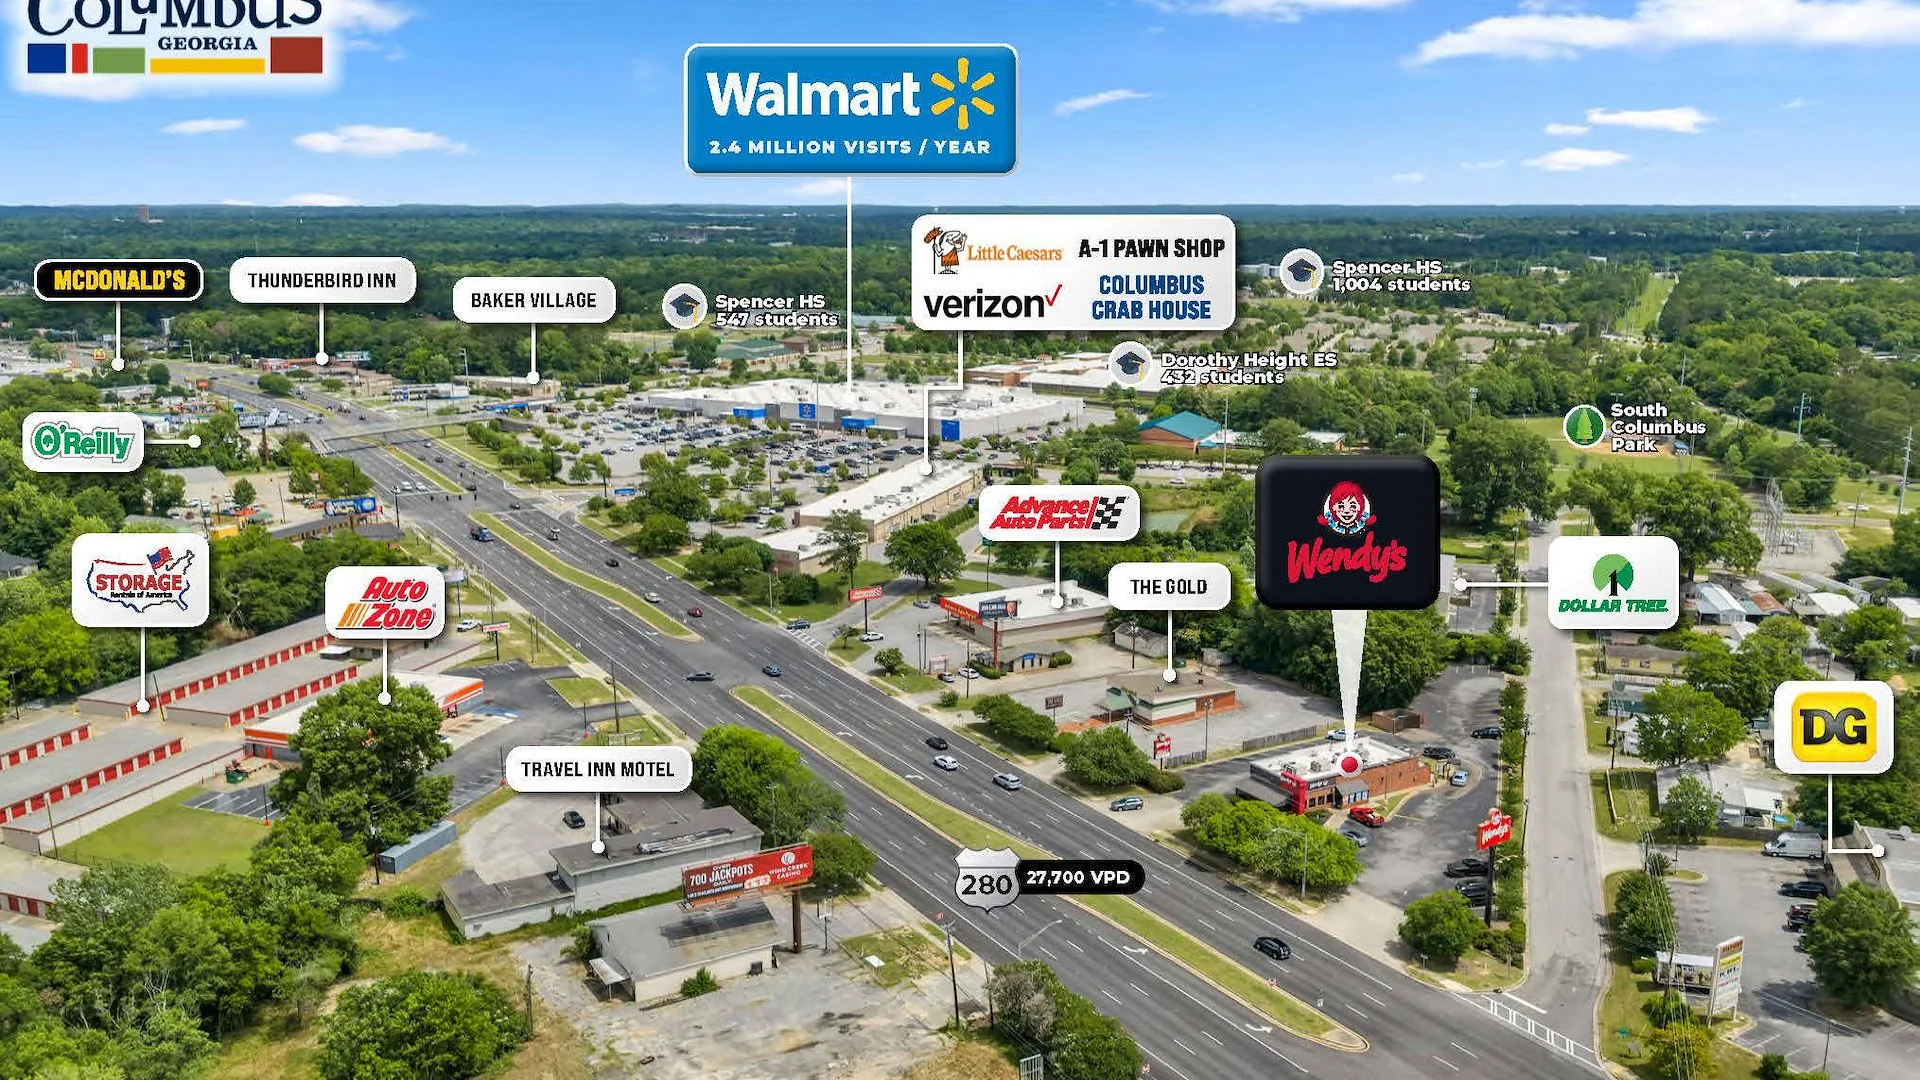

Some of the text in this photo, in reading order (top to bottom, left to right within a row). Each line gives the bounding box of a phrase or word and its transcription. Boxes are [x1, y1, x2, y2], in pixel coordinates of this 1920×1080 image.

[1482, 823, 1509, 845] Wendy's
[690, 873, 707, 886] 700
[709, 863, 754, 882] JACKPOTS
